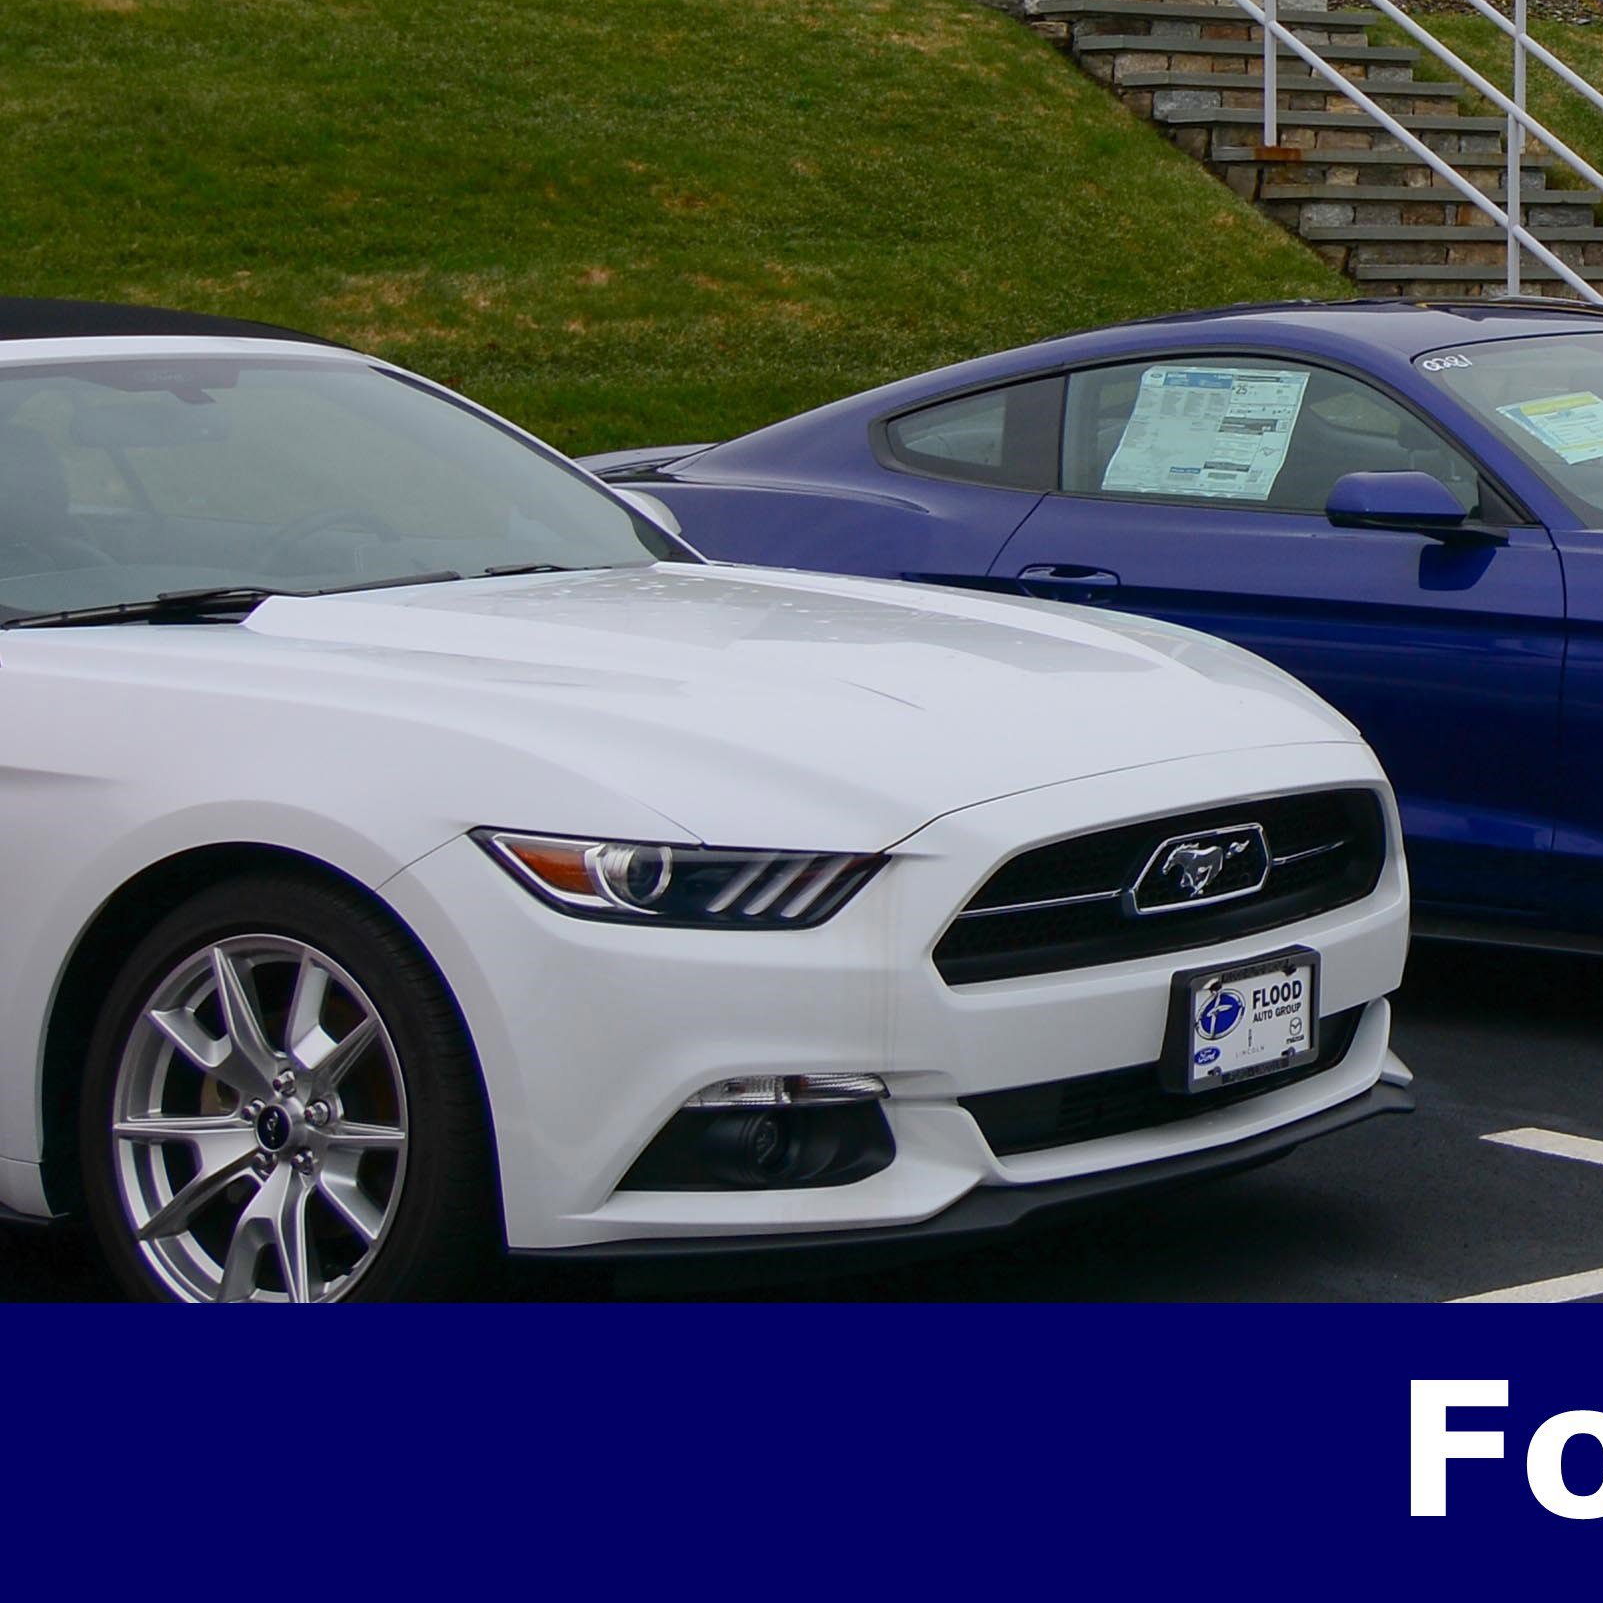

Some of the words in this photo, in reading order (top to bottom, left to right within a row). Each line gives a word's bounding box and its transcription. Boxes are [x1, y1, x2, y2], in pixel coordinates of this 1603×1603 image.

[1252, 980, 1303, 1010] FLOOD
[1252, 1007, 1273, 1023] AUTO
[1275, 1002, 1302, 1017] GROUP
[1198, 1050, 1217, 1064] Ford
